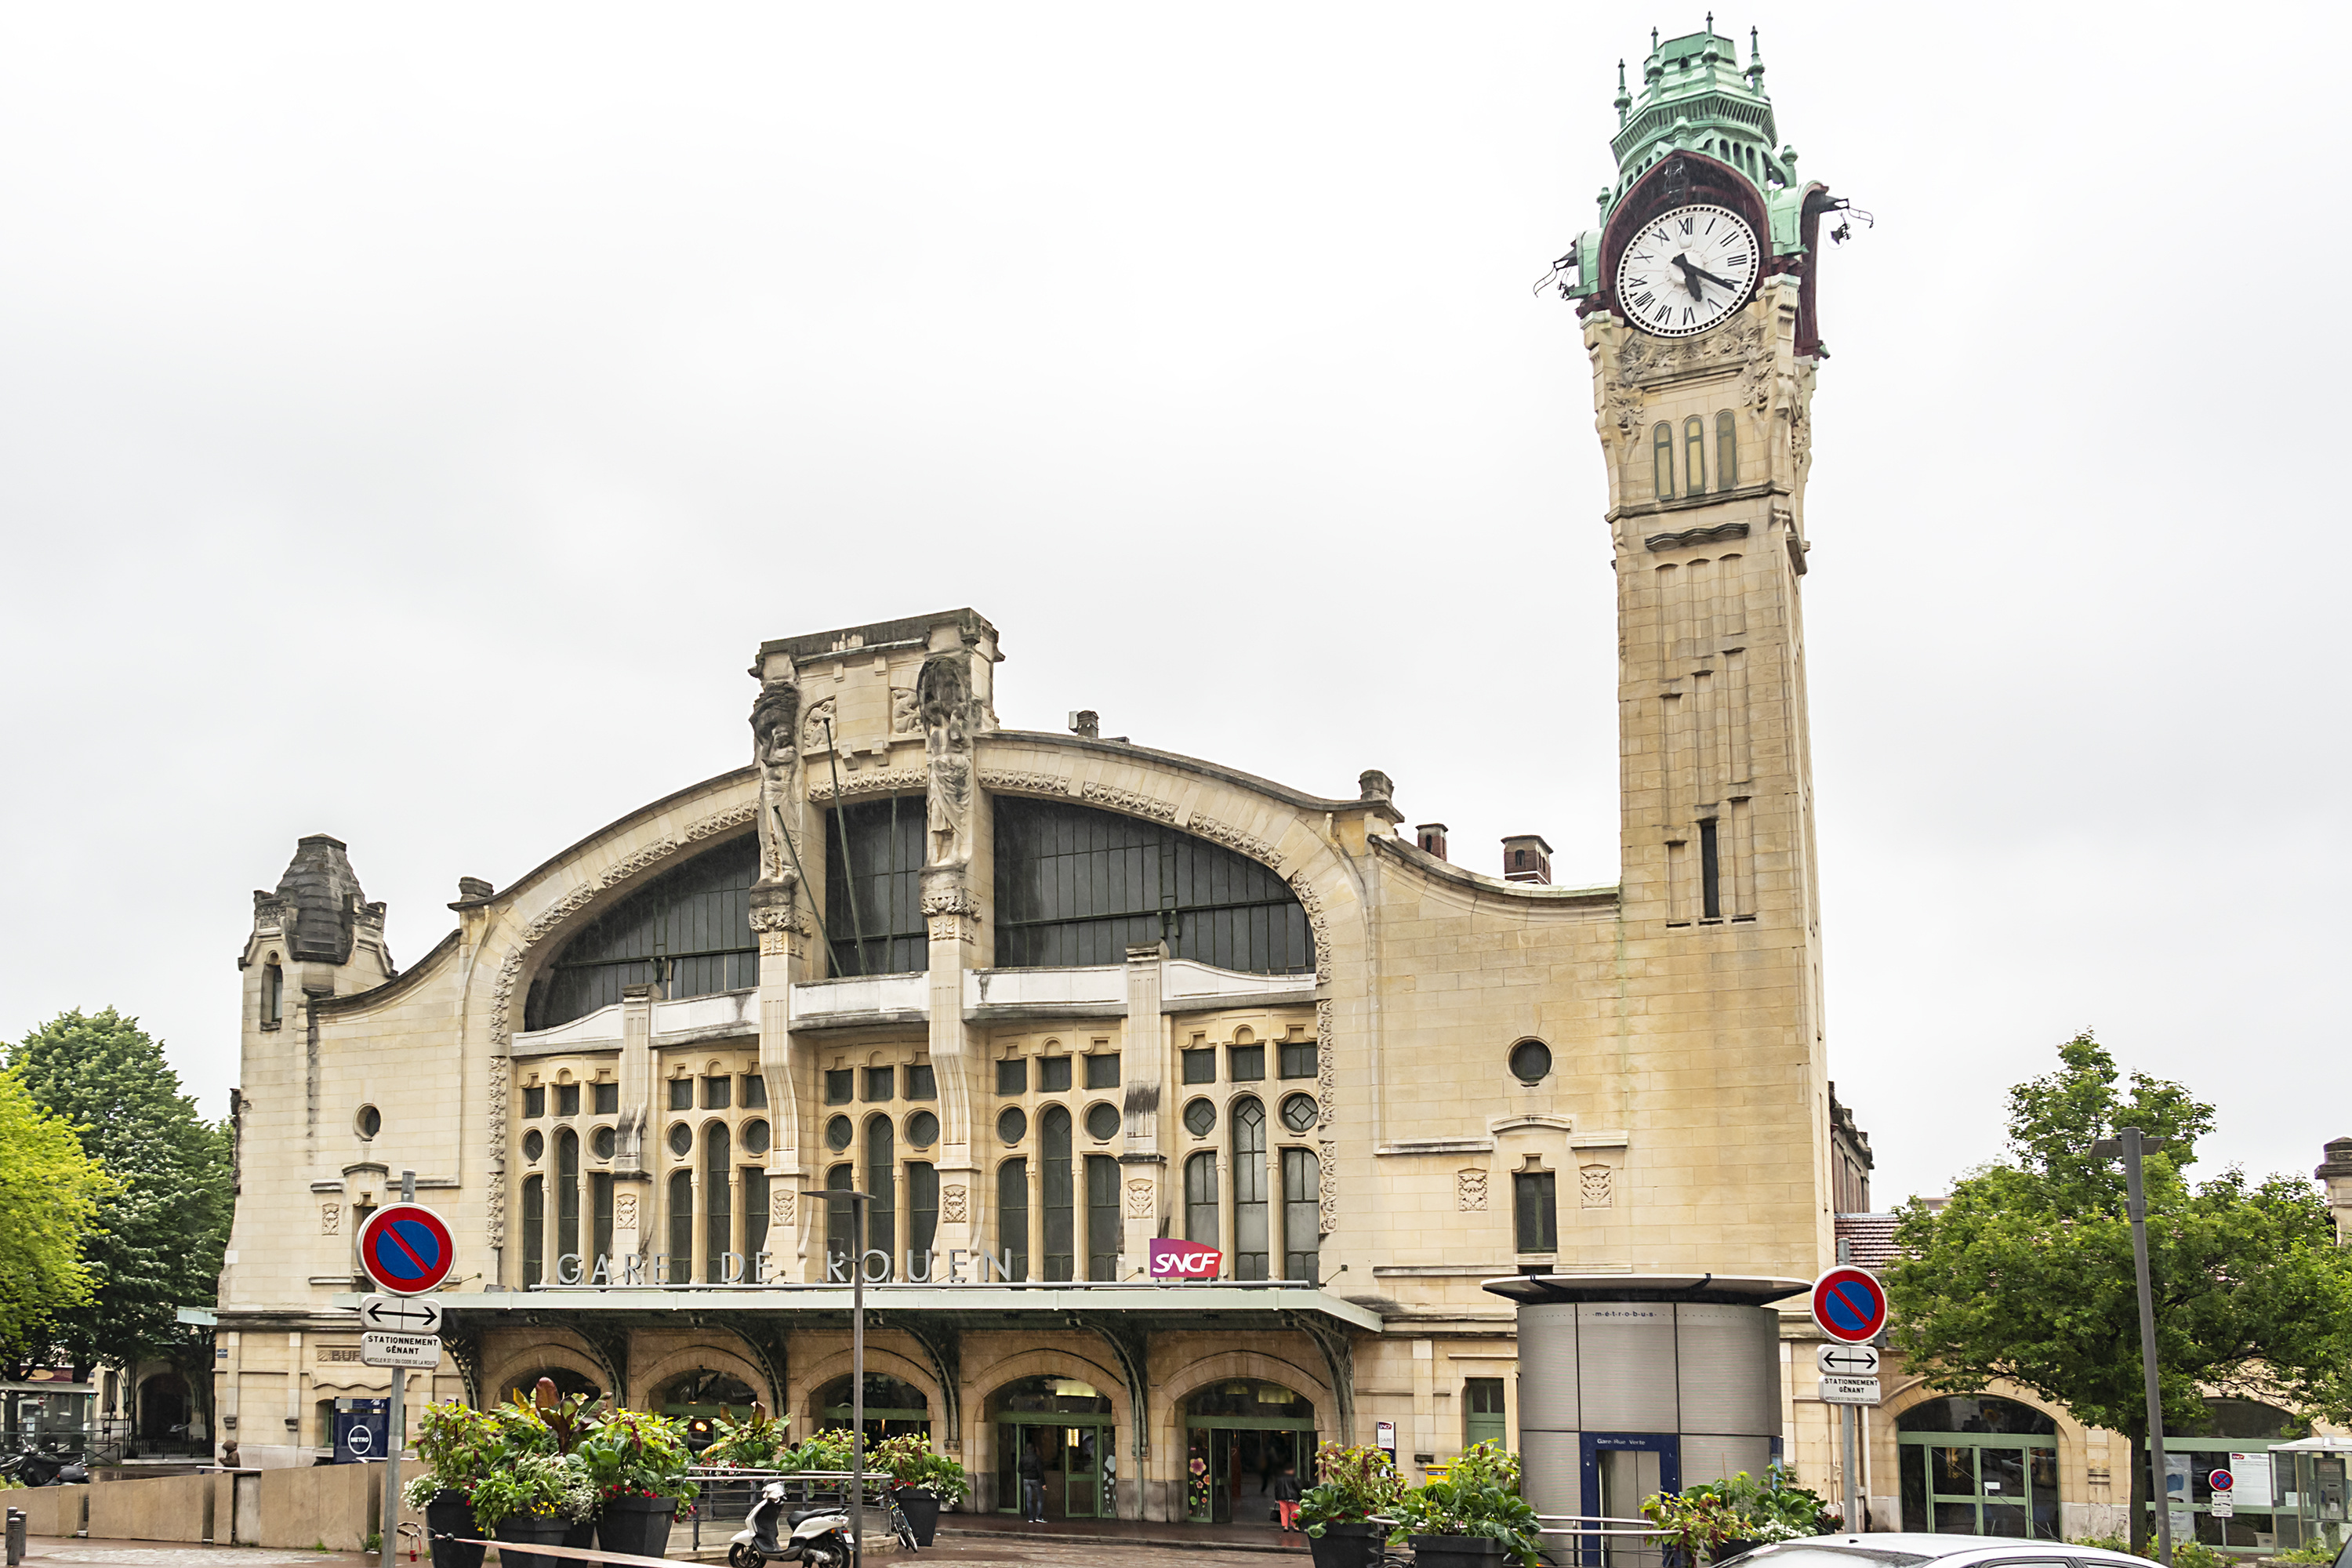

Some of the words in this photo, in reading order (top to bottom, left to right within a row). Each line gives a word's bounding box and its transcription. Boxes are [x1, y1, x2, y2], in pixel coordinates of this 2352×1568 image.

[1678, 217, 1693, 237] XII
[1704, 218, 1716, 235] I
[1651, 227, 1671, 247] XI
[1719, 230, 1740, 248] II
[1633, 249, 1654, 263] X
[1727, 254, 1748, 267] III
[1628, 274, 1648, 288] IX
[1634, 291, 1657, 314] VIII
[1707, 298, 1723, 315] V
[1653, 304, 1672, 325] VII
[1682, 307, 1696, 326] VI
[557, 1253, 670, 1284] GARE
[720, 1252, 773, 1283] DE
[826, 1248, 1012, 1283] ROUEN
[1152, 1253, 1218, 1273] SNCF
[368, 1335, 438, 1346] STATIONNEMENT
[386, 1345, 419, 1355] GÊNANT
